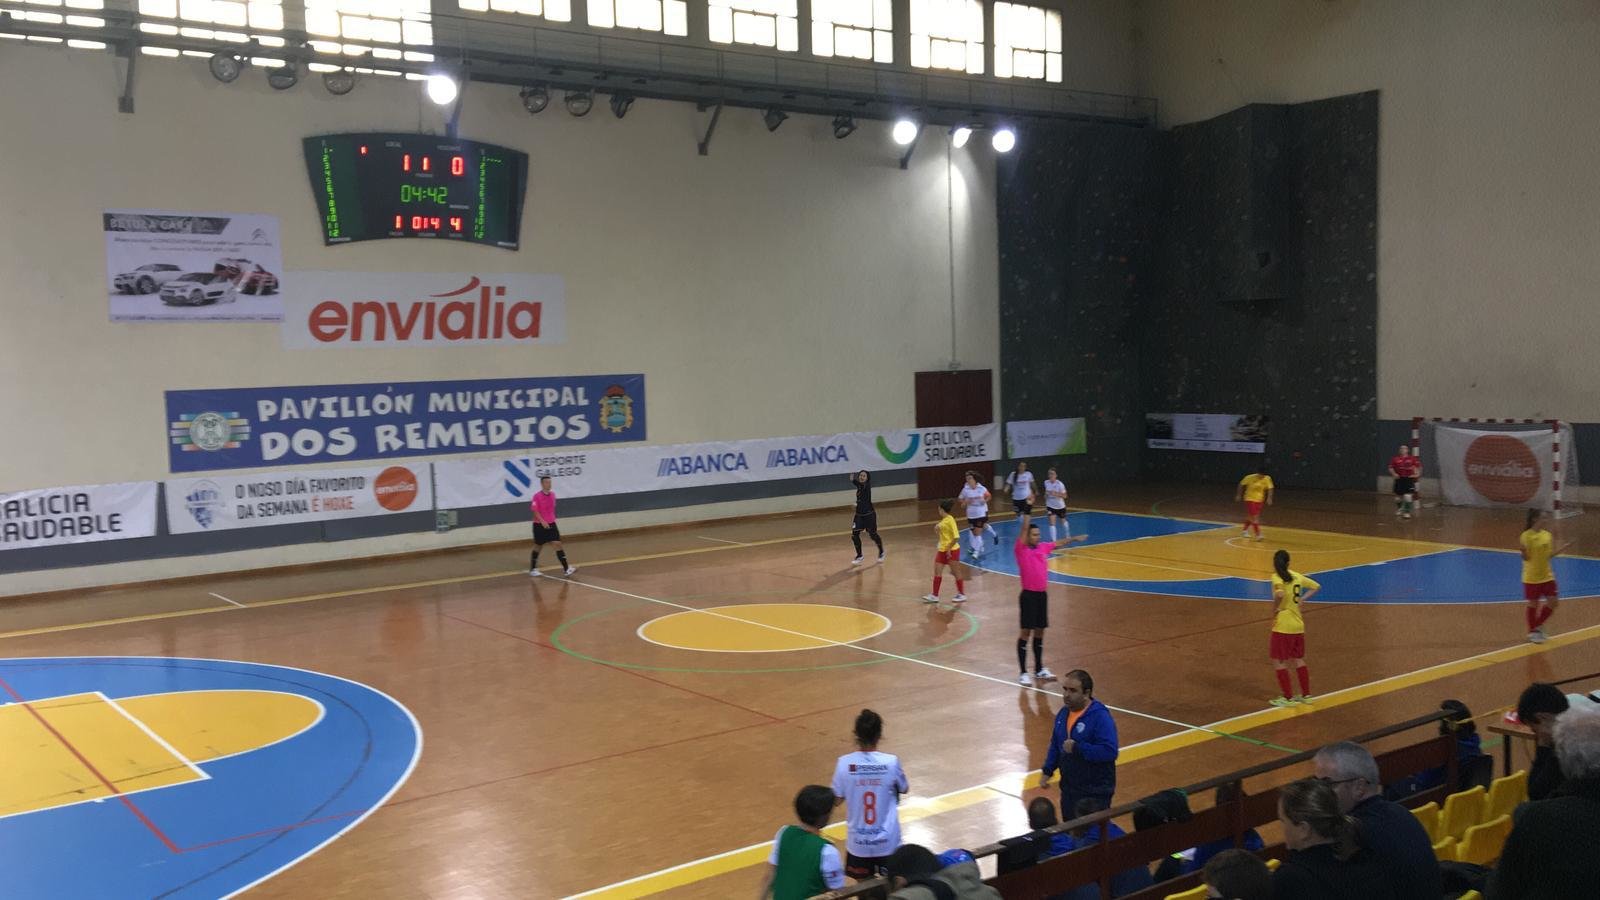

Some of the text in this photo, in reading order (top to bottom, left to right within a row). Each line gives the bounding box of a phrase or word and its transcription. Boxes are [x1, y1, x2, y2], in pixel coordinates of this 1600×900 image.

[451, 156, 464, 175] 0
[401, 184, 448, 204] 04:42
[450, 217, 462, 231] 4
[257, 386, 590, 422] PAVILLÓN MUNICIPAL
[260, 414, 591, 460] DOS REMEDIOS
[924, 430, 973, 447] GALICIA
[535, 454, 586, 467] DEPORTE
[774, 444, 849, 468] ABANCA
[925, 443, 987, 462] SAUDABLE
[536, 466, 582, 478] GALEGO
[667, 452, 749, 476] ABANCA
[235, 484, 246, 499] O
[247, 481, 283, 498] NOSO
[285, 477, 307, 495] DÍA
[309, 476, 366, 493] FAVORITO
[0, 493, 90, 521] ALICIA
[237, 504, 255, 519] DA
[257, 499, 309, 518] SEMANA
[0, 513, 123, 543] AUDABLE
[1292, 584, 1301, 604] 8
[863, 791, 877, 825] 8
